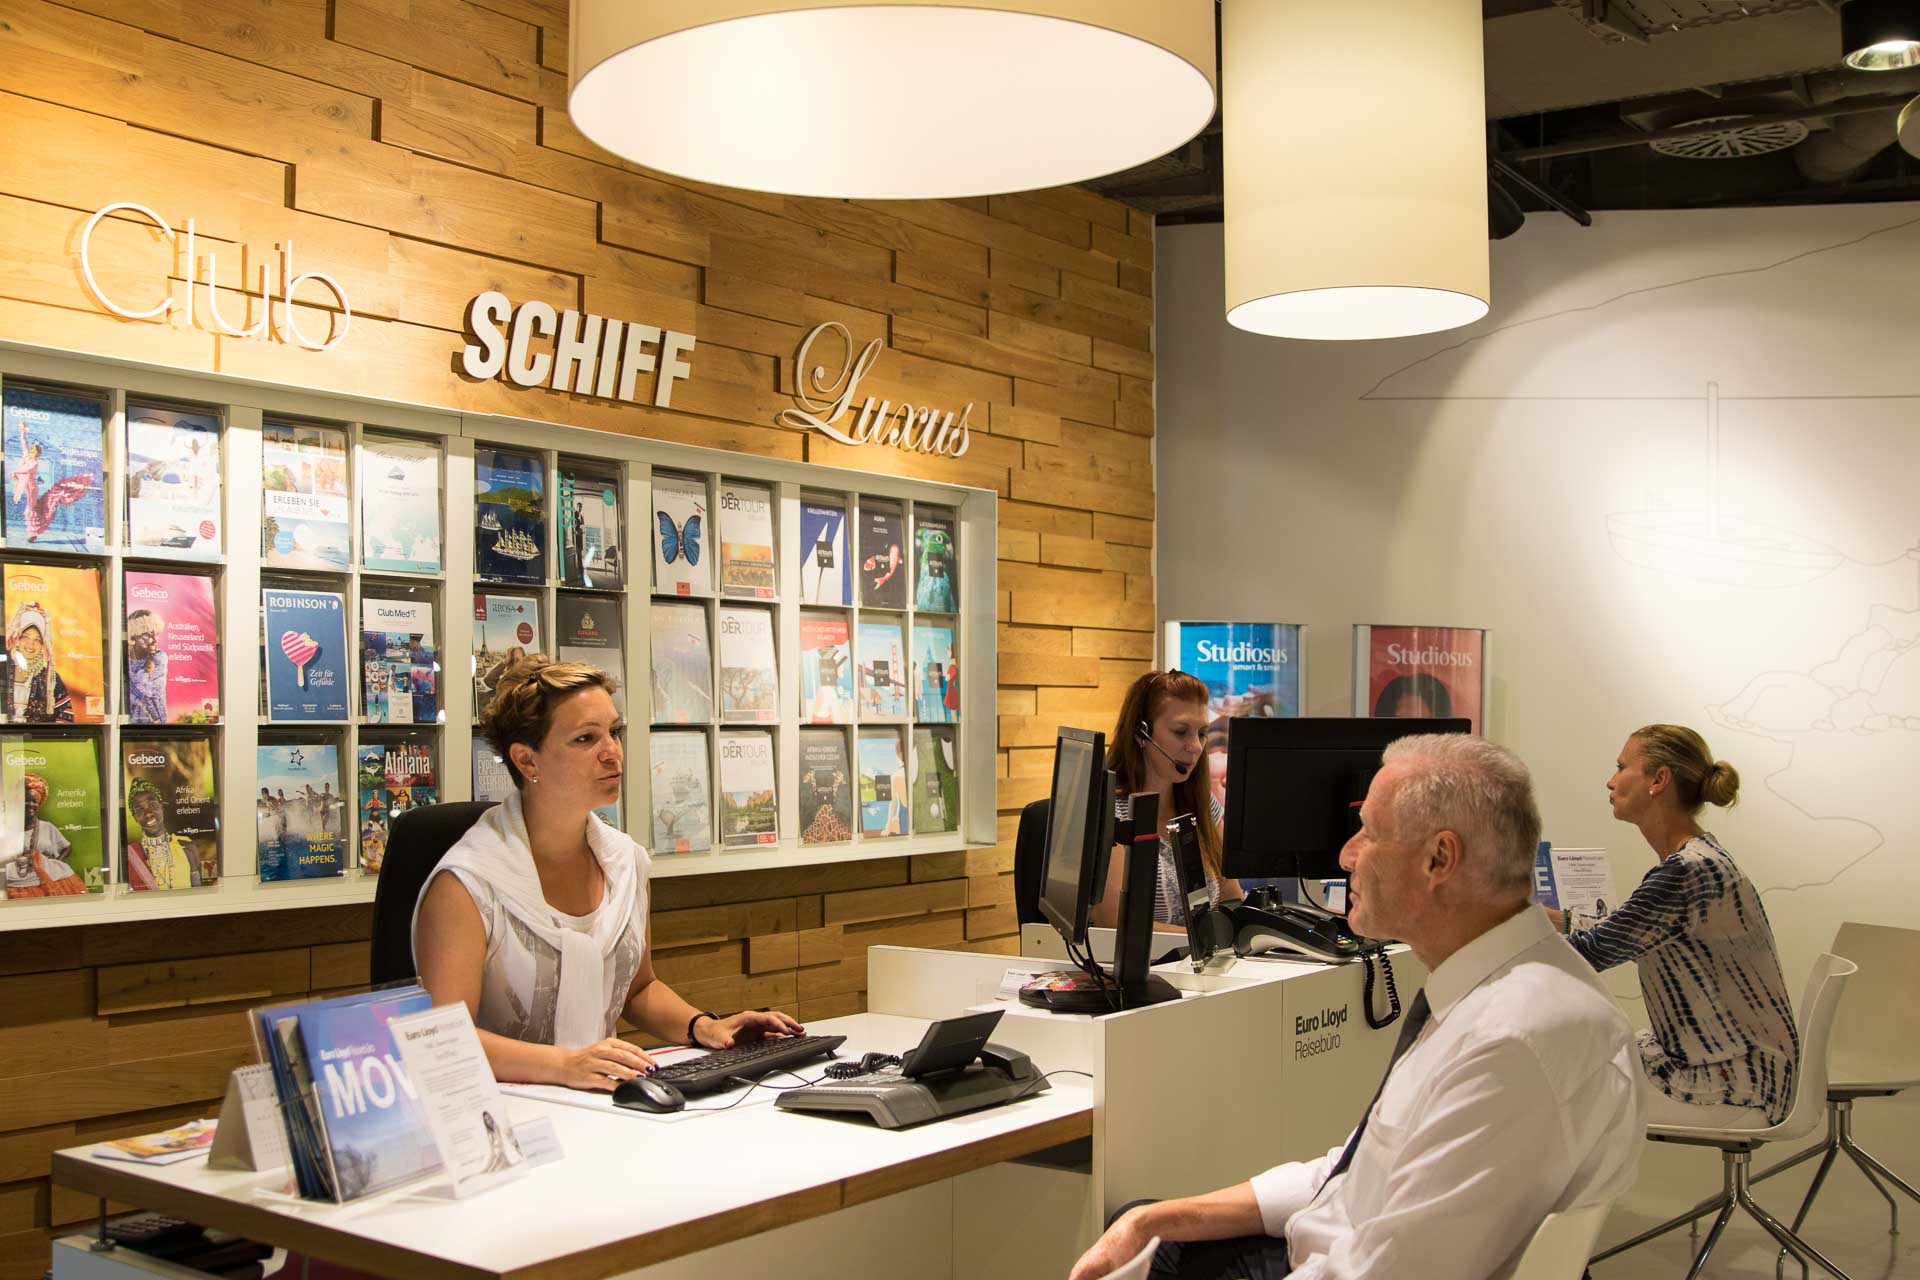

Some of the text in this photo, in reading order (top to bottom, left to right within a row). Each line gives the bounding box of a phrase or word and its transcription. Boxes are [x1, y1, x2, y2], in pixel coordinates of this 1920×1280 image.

[80, 202, 351, 351] Club
[462, 290, 697, 407] SCHIFF
[781, 321, 973, 457] Luxus
[10, 406, 49, 420] Gebeco
[273, 495, 320, 507] ERLEBEN SIE
[721, 496, 766, 513] DERTOUR
[8, 579, 49, 592] Gebeco
[131, 586, 169, 599] Gebeco
[269, 597, 327, 610] ROBINSON
[168, 632, 205, 641] Neuseeland
[168, 643, 181, 651] und
[1196, 639, 1288, 664] Studiosus
[168, 653, 193, 661] erleben
[1386, 643, 1473, 667] Studiosus
[310, 669, 335, 679] Zeit für
[310, 677, 335, 688] Gefühle
[722, 744, 768, 759] DERTOUR
[6, 753, 47, 766] Gebeco
[128, 753, 166, 765] Gebeco
[384, 751, 431, 775] Aldiana
[57, 788, 87, 797] Amerika
[175, 786, 195, 794] Afrika
[57, 799, 84, 808] erleben
[176, 796, 211, 804] und Orient
[176, 806, 201, 815] erleben
[306, 831, 334, 841] WHERE
[309, 843, 335, 852] MAGIC
[299, 854, 337, 865] HAPPENS.
[1295, 1003, 1348, 1035] Euro Lloyd
[405, 1025, 439, 1041] Euro Lloyd
[1295, 1033, 1341, 1060] Reisebüro
